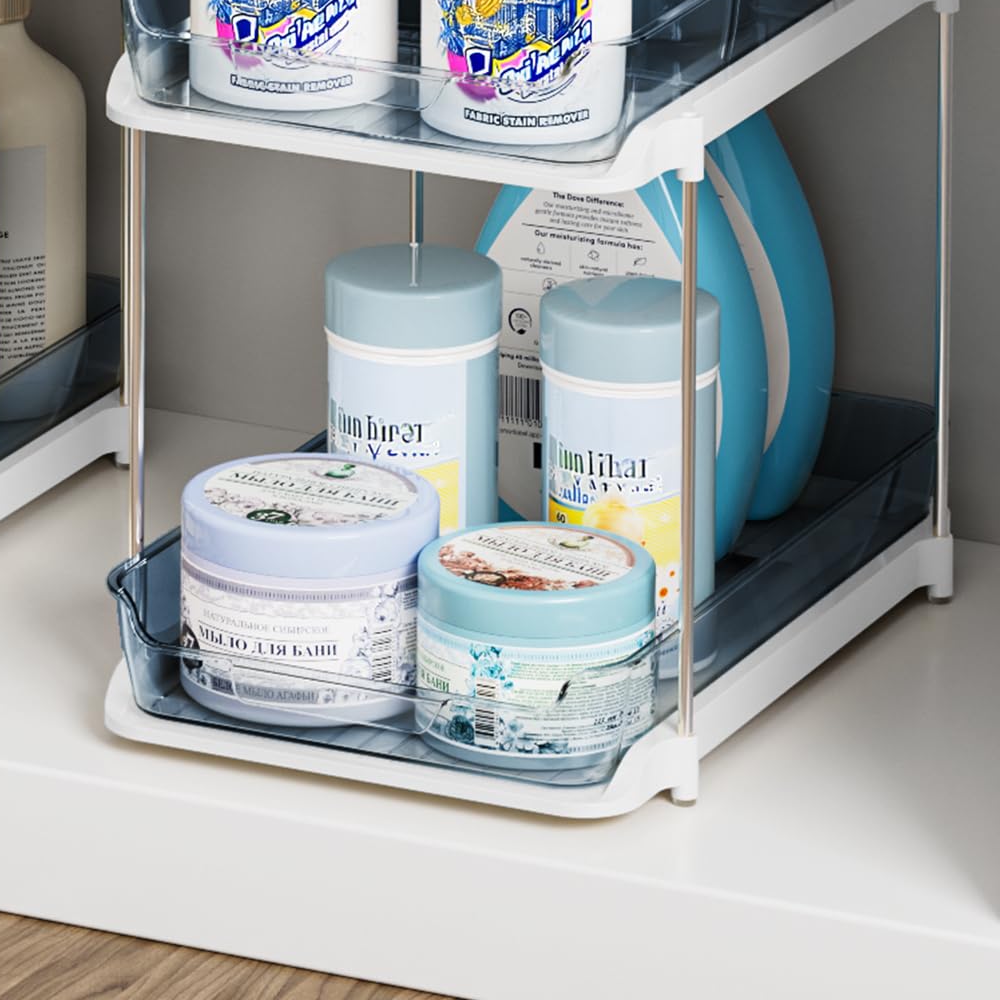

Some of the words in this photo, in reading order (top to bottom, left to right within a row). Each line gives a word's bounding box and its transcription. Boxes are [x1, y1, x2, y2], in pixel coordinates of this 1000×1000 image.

[303, 74, 353, 93] REMOVER
[463, 107, 502, 126] FABRIC
[502, 115, 537, 128] STAIN
[538, 109, 590, 127] REMOVER
[552, 191, 566, 201] The
[567, 193, 584, 203] Dove
[585, 195, 625, 208] Difference:
[534, 229, 548, 238] Our
[549, 232, 596, 246] moisturizing
[597, 237, 626, 249] formula
[627, 242, 644, 251] has:
[202, 608, 269, 632] НАТУРАЛЬНОЕ
[272, 623, 329, 635] СИБИРСКОЕ
[198, 624, 248, 652] МЫЛО
[251, 640, 287, 656] ДЛЯ
[292, 643, 338, 657] БАНИ
[243, 685, 276, 700] МЫЛО
[426, 672, 450, 693] БАНИ
